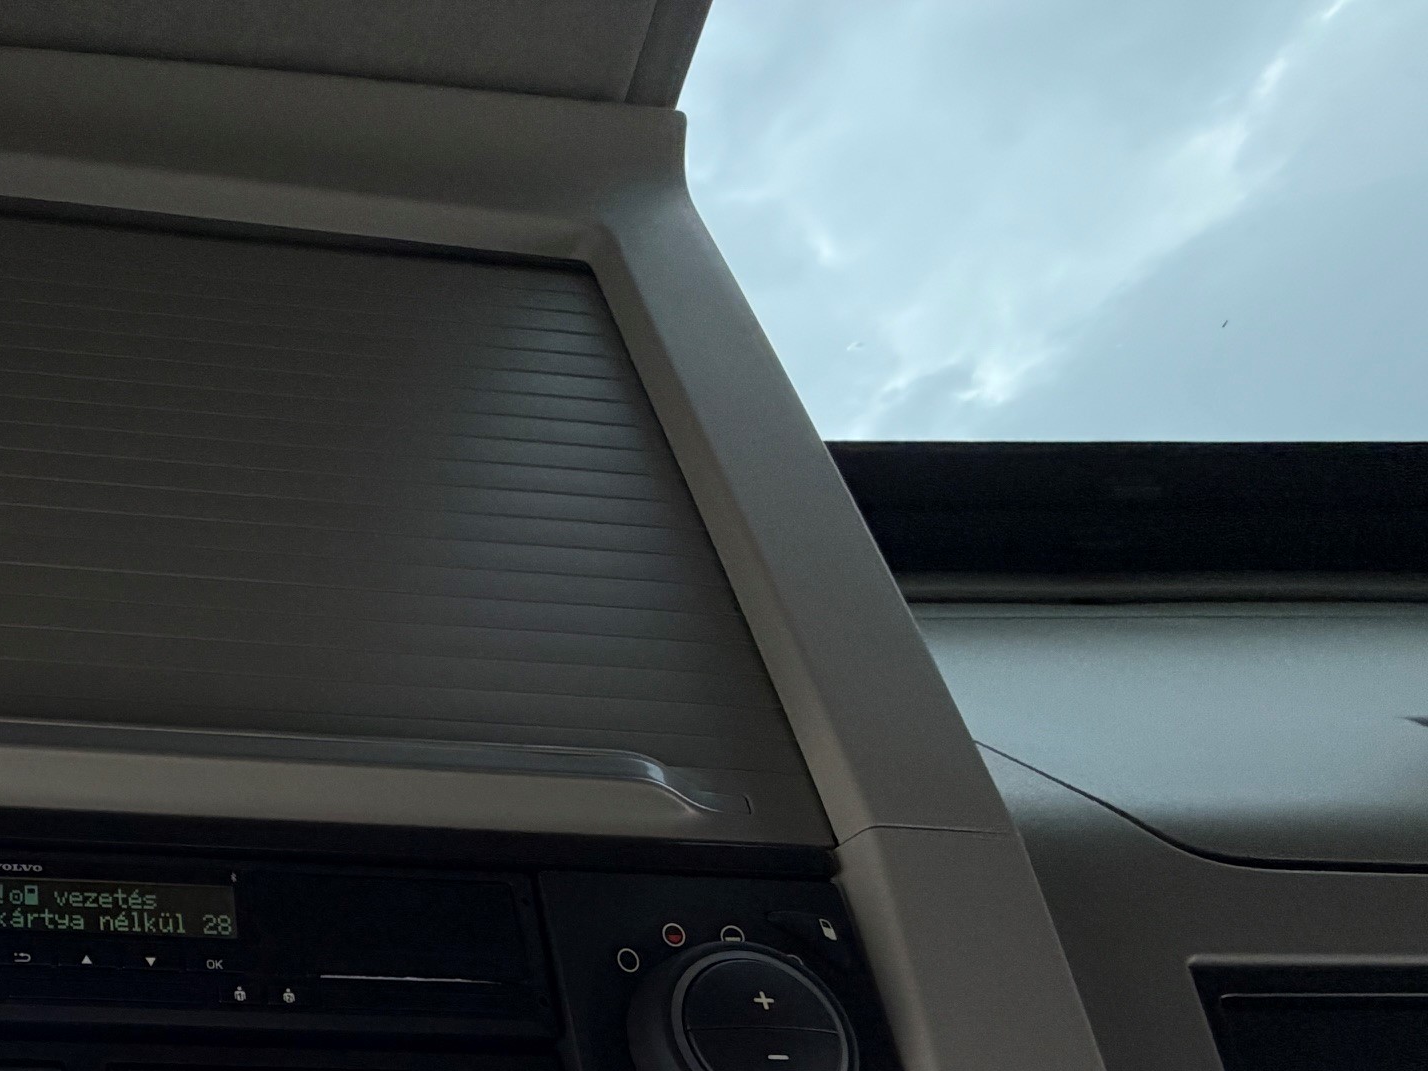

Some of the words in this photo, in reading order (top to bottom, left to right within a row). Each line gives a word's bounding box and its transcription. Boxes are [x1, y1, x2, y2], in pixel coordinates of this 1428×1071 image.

[54, 889, 157, 910] vezetés
[99, 912, 186, 934] nélkül
[203, 914, 232, 935] 28
[206, 959, 224, 970] OK
